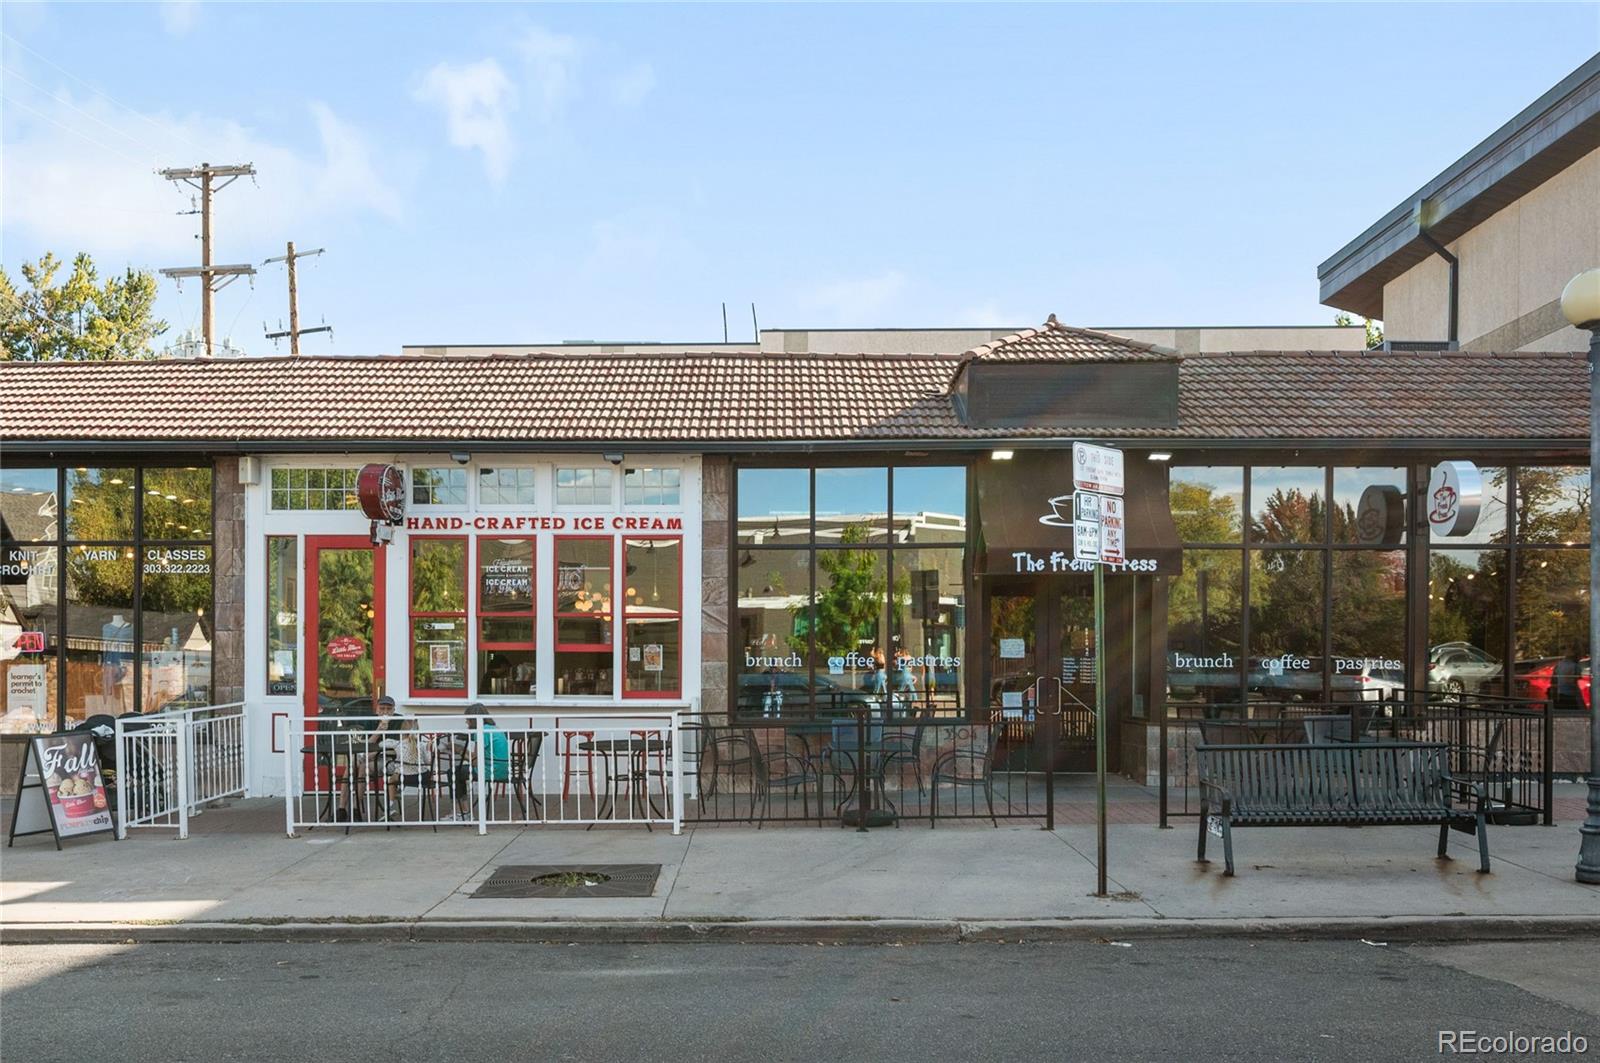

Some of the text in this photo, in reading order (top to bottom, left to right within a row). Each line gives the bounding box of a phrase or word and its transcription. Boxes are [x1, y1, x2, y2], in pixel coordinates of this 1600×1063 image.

[1106, 501, 1116, 514] NO
[407, 517, 682, 530] HAND-CRAFTED ICE CREAM
[1101, 515, 1121, 529] PARKING
[1107, 530, 1117, 539] ANY
[9, 550, 38, 561] KNIT
[83, 550, 117, 561] YARN
[147, 550, 206, 561] CLASSES
[1012, 551, 1045, 572] The
[1050, 551, 1095, 572] Frenc
[143, 564, 210, 574] 303.322.2223
[486, 578, 528, 586] ICE CREAM
[745, 652, 802, 667] brunch
[828, 652, 875, 667] coffee
[897, 654, 960, 671] pastries
[1175, 652, 1234, 668] brunch
[1262, 654, 1310, 669] coffee
[1335, 656, 1401, 674] pastries
[11, 687, 36, 695] crochet
[42, 742, 97, 781] Fall
[93, 815, 109, 825] chip
